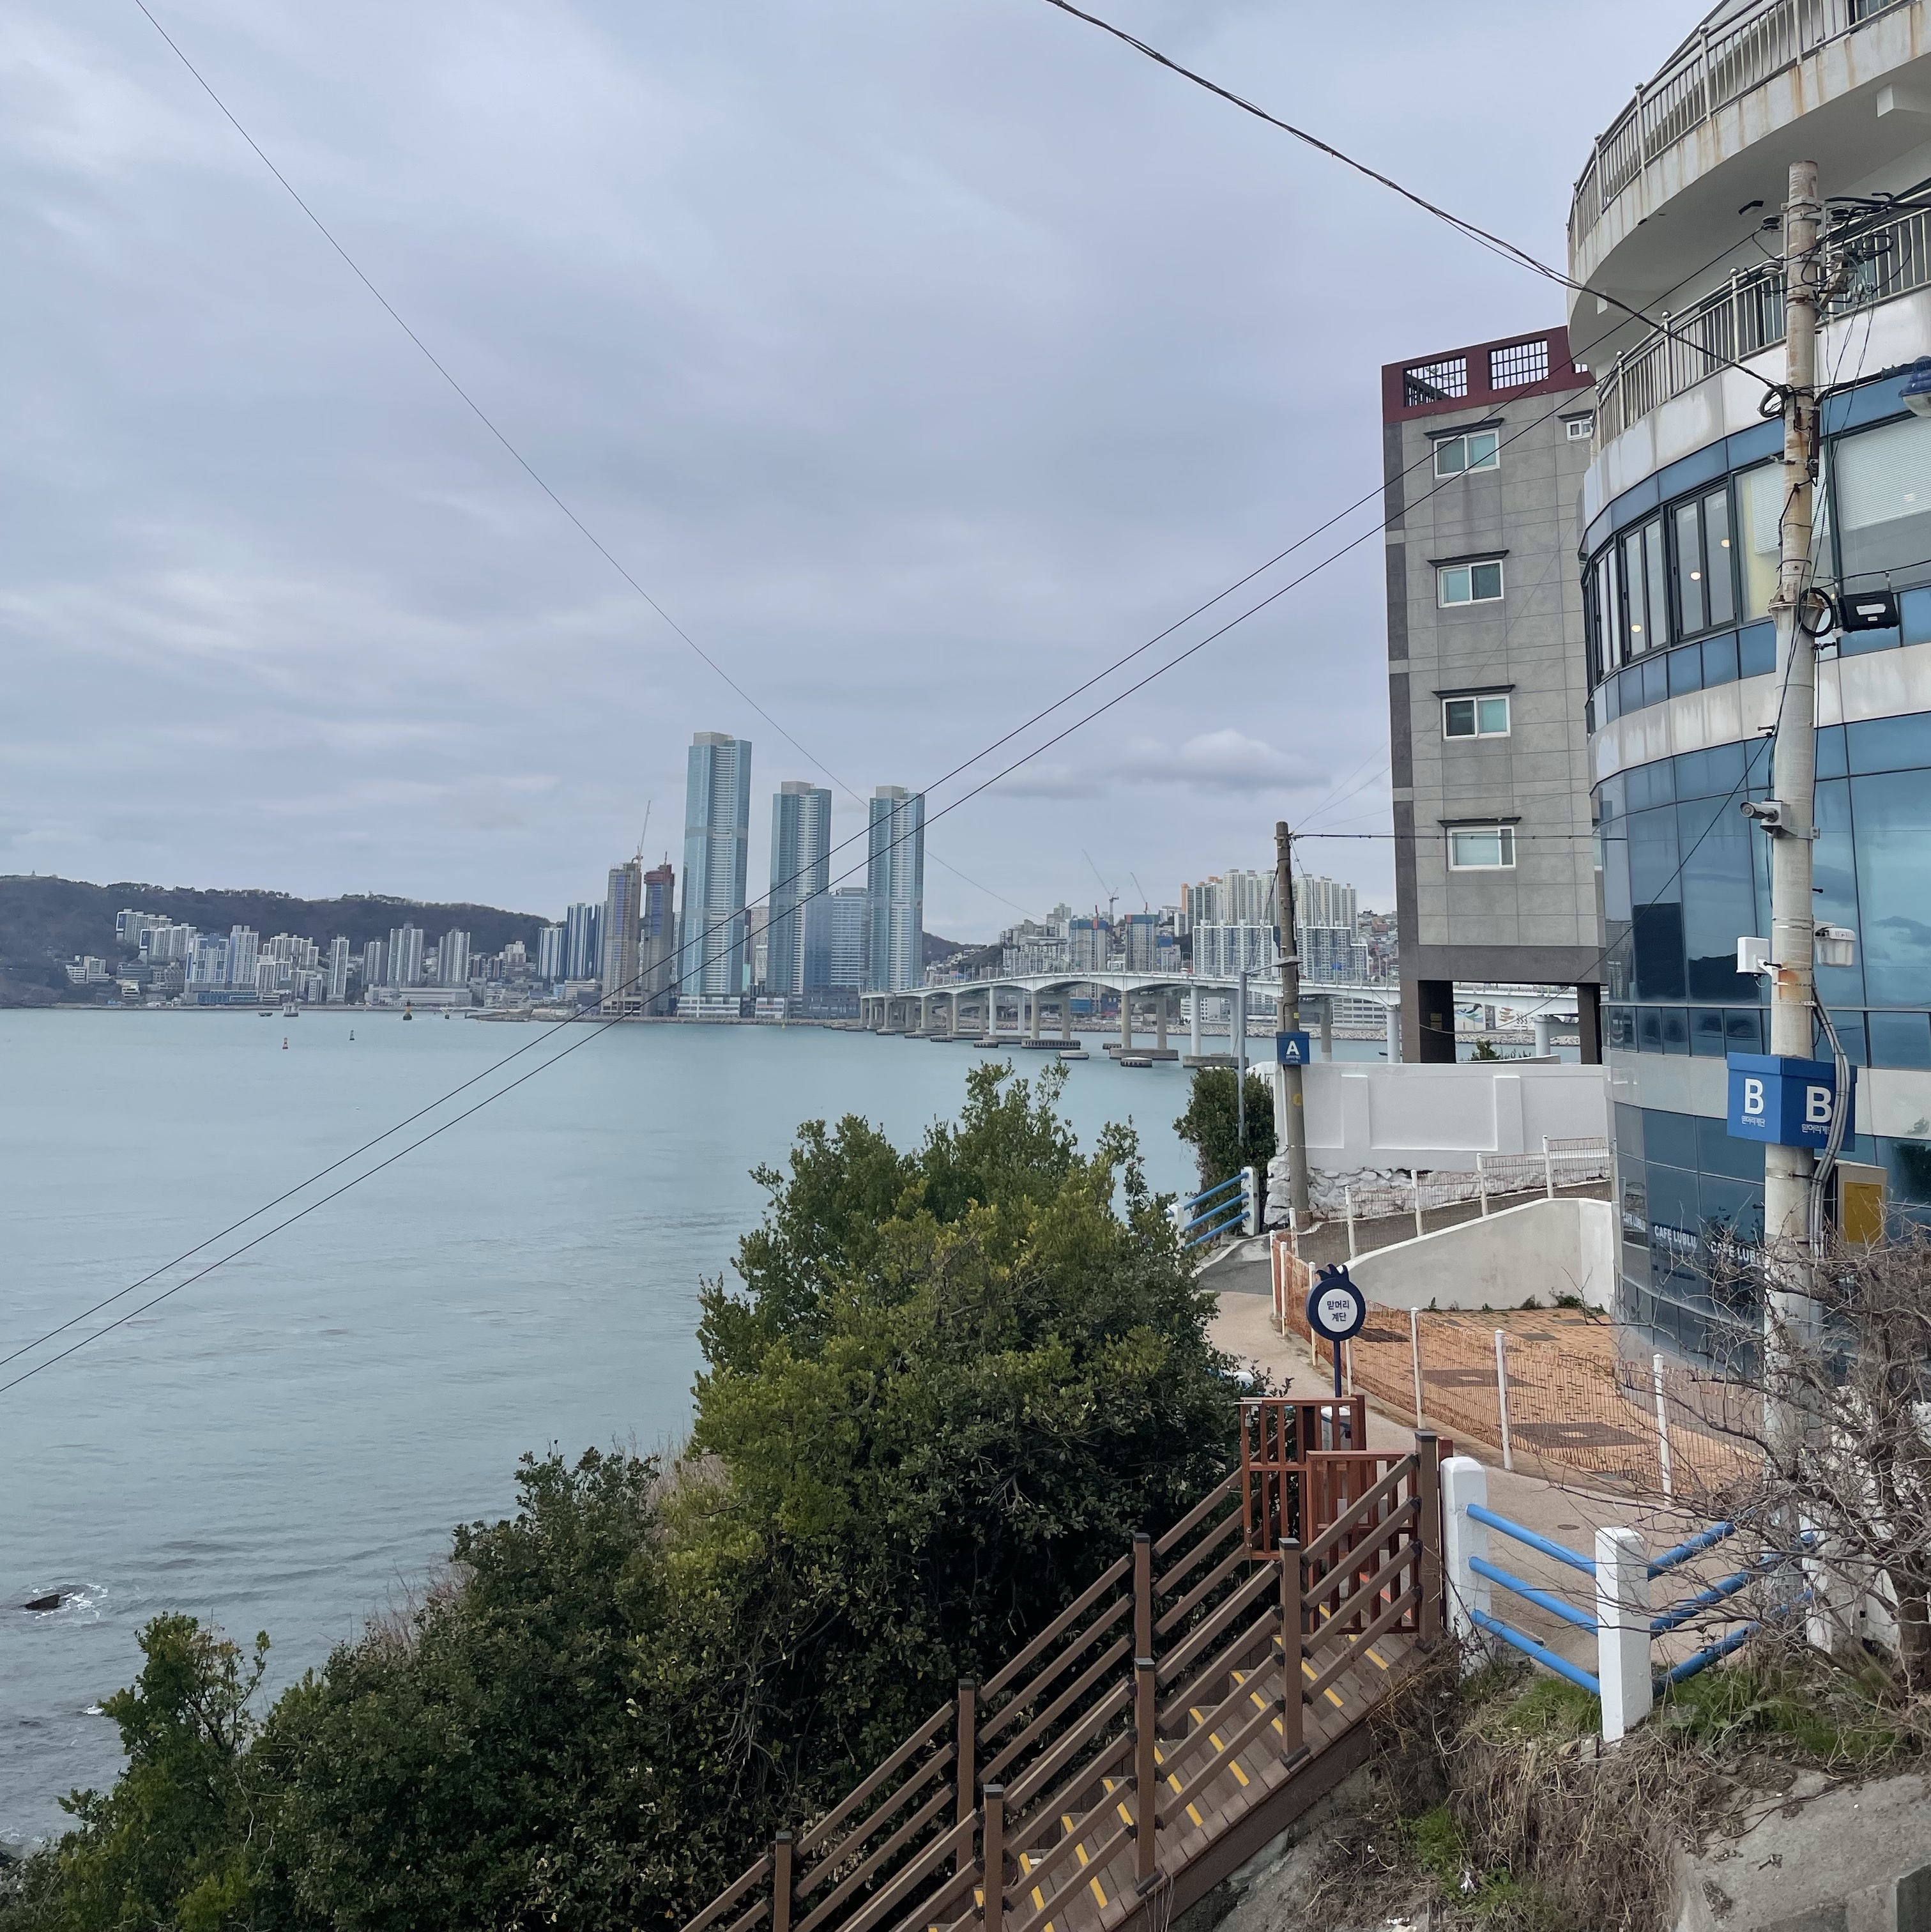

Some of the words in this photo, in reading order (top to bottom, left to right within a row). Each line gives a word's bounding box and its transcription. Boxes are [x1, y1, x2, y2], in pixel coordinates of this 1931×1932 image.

[1286, 1040, 1300, 1055] A
[1744, 1078, 1764, 1114] B
[1806, 1085, 1832, 1123] B
[1654, 1225, 1672, 1241] CAFE
[1673, 1230, 1697, 1248] LUBLU
[1327, 1300, 1350, 1310] 맏머리
[1331, 1312, 1347, 1322] 계단
